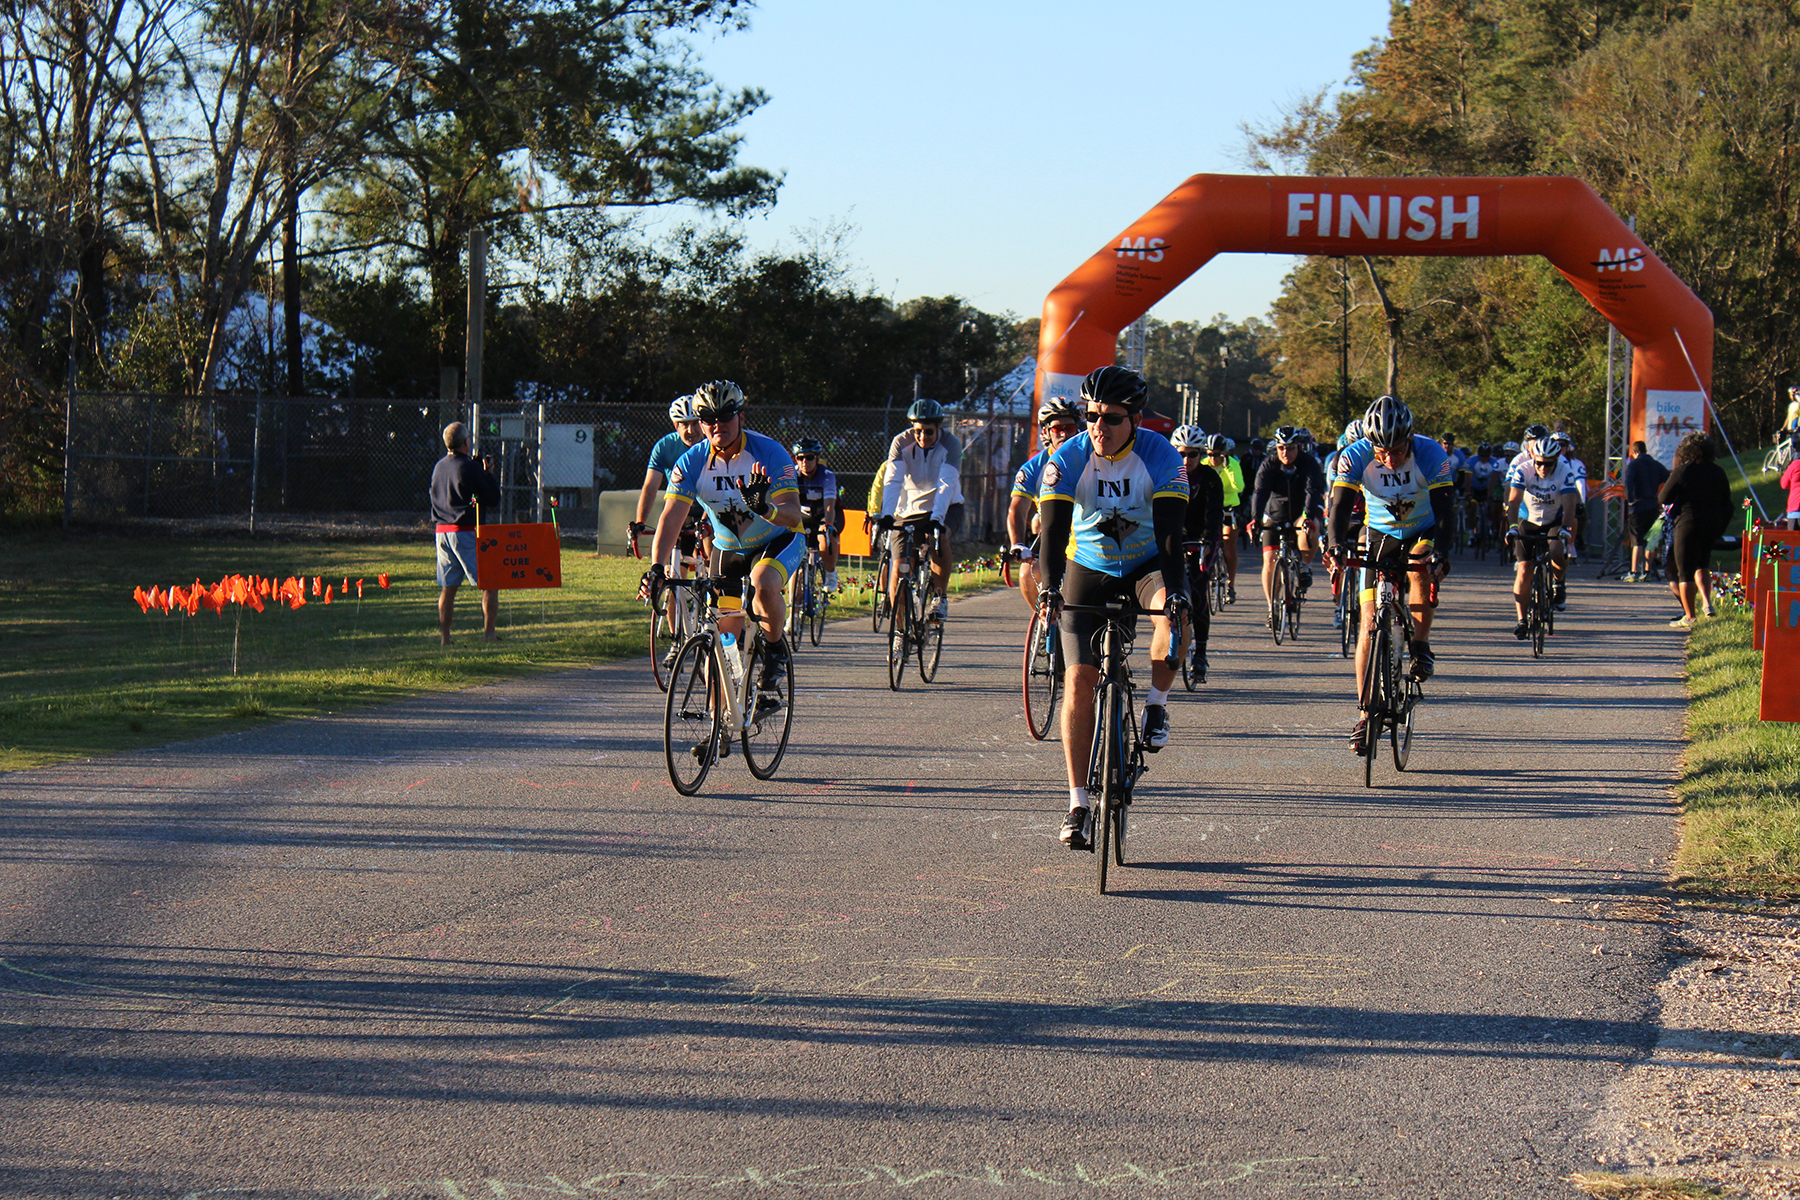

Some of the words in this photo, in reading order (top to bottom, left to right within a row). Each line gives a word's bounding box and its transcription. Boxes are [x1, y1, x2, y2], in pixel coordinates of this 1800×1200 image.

[1287, 193, 1480, 241] FINISH
[1117, 236, 1165, 263] MS
[1597, 247, 1645, 273] MS
[1116, 270, 1139, 278] Multiple
[1051, 384, 1074, 396] bike
[1656, 402, 1681, 413] bike
[1656, 415, 1695, 437] MS
[575, 429, 587, 444] 9
[1380, 471, 1411, 487] TNJ
[1097, 478, 1131, 498] TNJ
[508, 530, 522, 539] WE
[505, 543, 527, 552] CAN
[503, 557, 530, 566] CURE
[511, 570, 526, 579] MS
